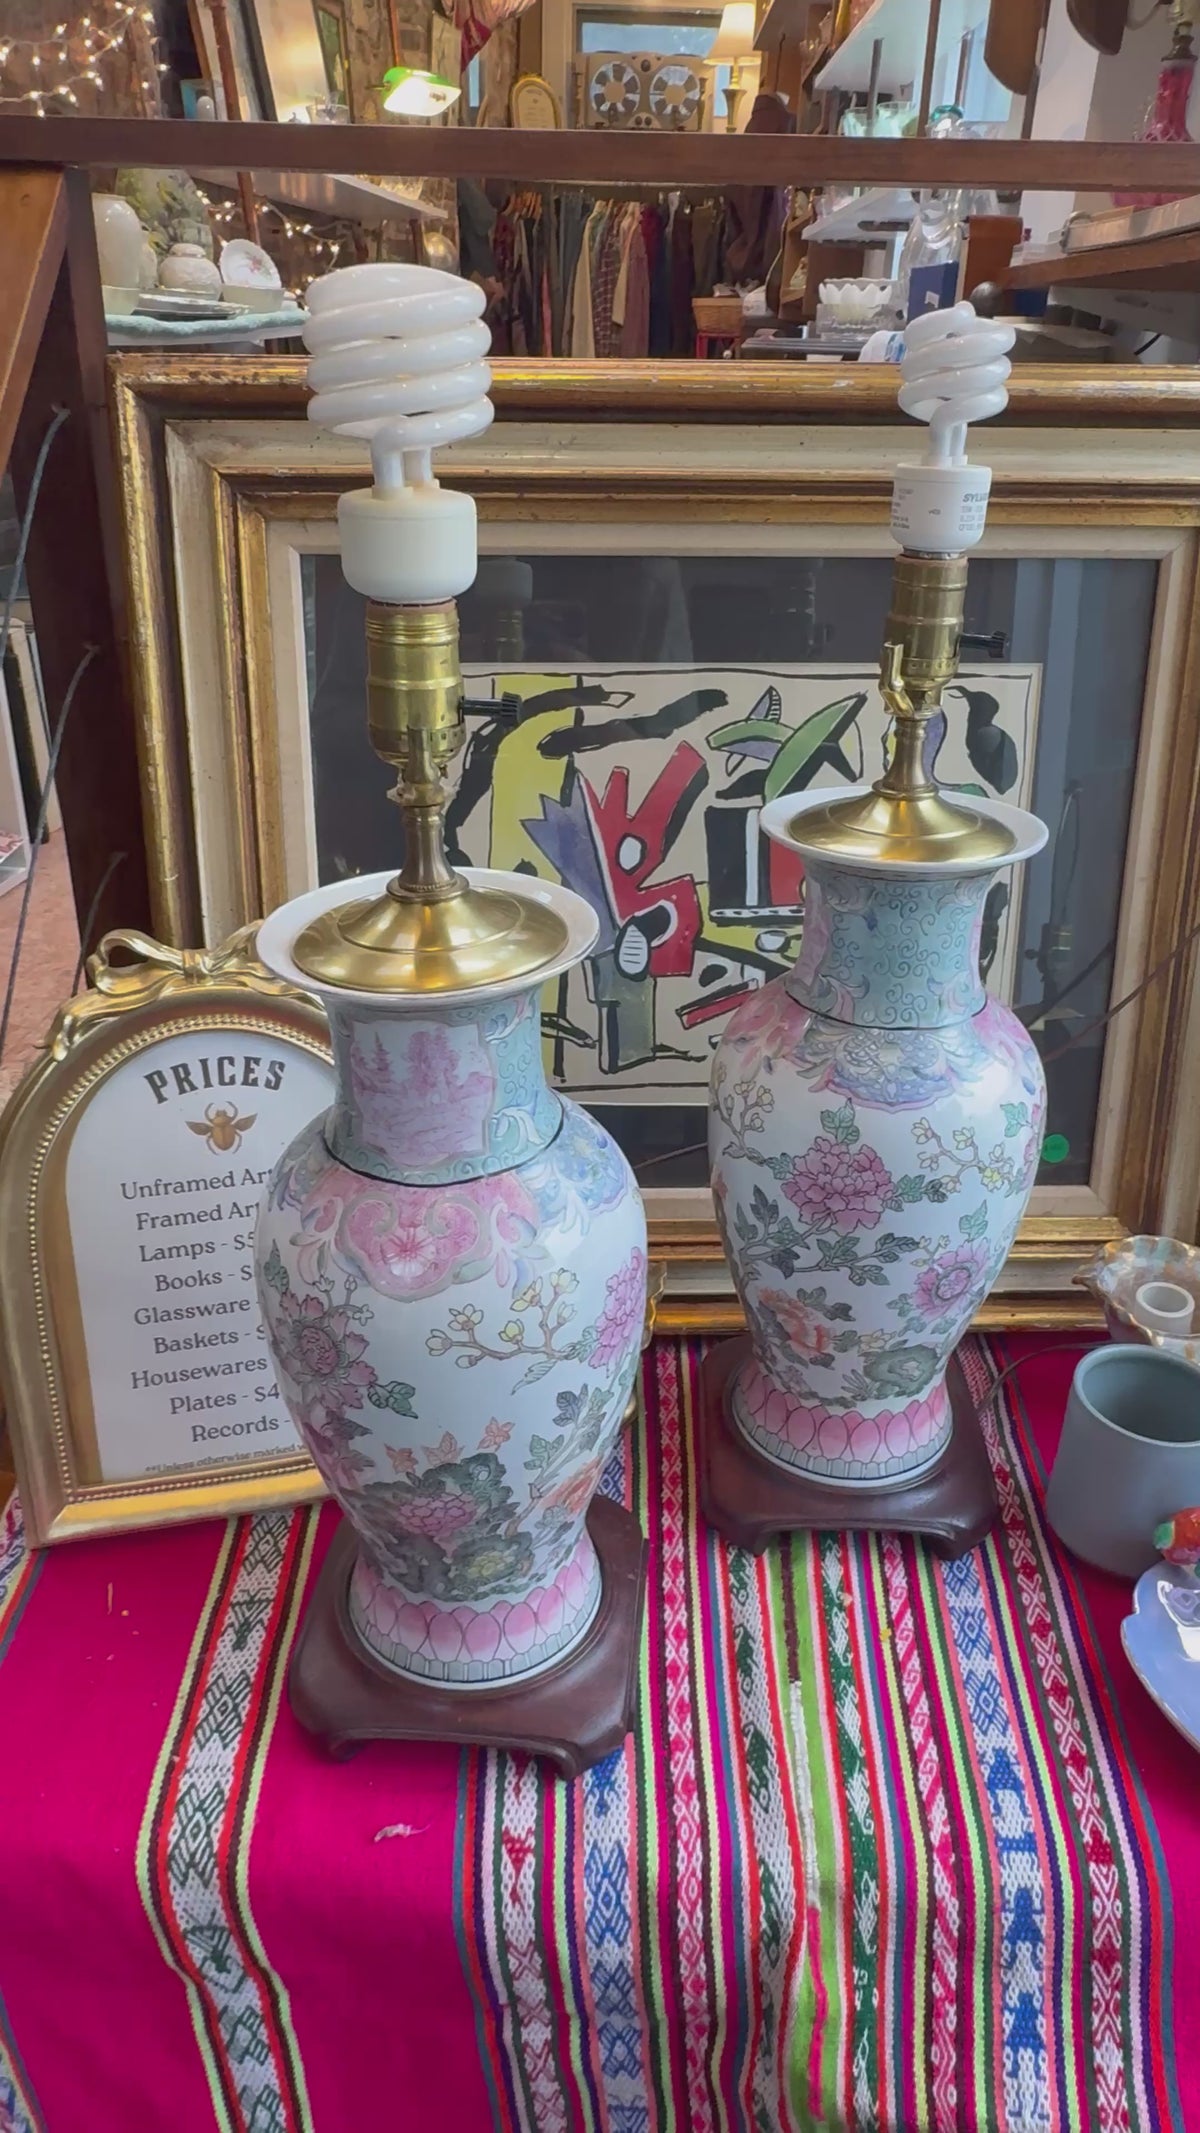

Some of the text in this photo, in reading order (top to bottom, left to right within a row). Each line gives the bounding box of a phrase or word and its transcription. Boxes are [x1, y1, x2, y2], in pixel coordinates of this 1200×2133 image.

[143, 1056, 286, 1104] PRICES
[120, 1170, 235, 1200] Unframed
[136, 1204, 223, 1231] Framed
[139, 1240, 216, 1263] Lamps
[155, 1269, 223, 1292] Books
[134, 1298, 251, 1326] Glassware
[153, 1330, 239, 1354] Baskets
[131, 1357, 268, 1389] Housewares
[169, 1392, 237, 1415] Plates
[191, 1415, 279, 1443] Records
[197, 1450, 251, 1468] otherwise
[253, 1443, 295, 1459] marked
